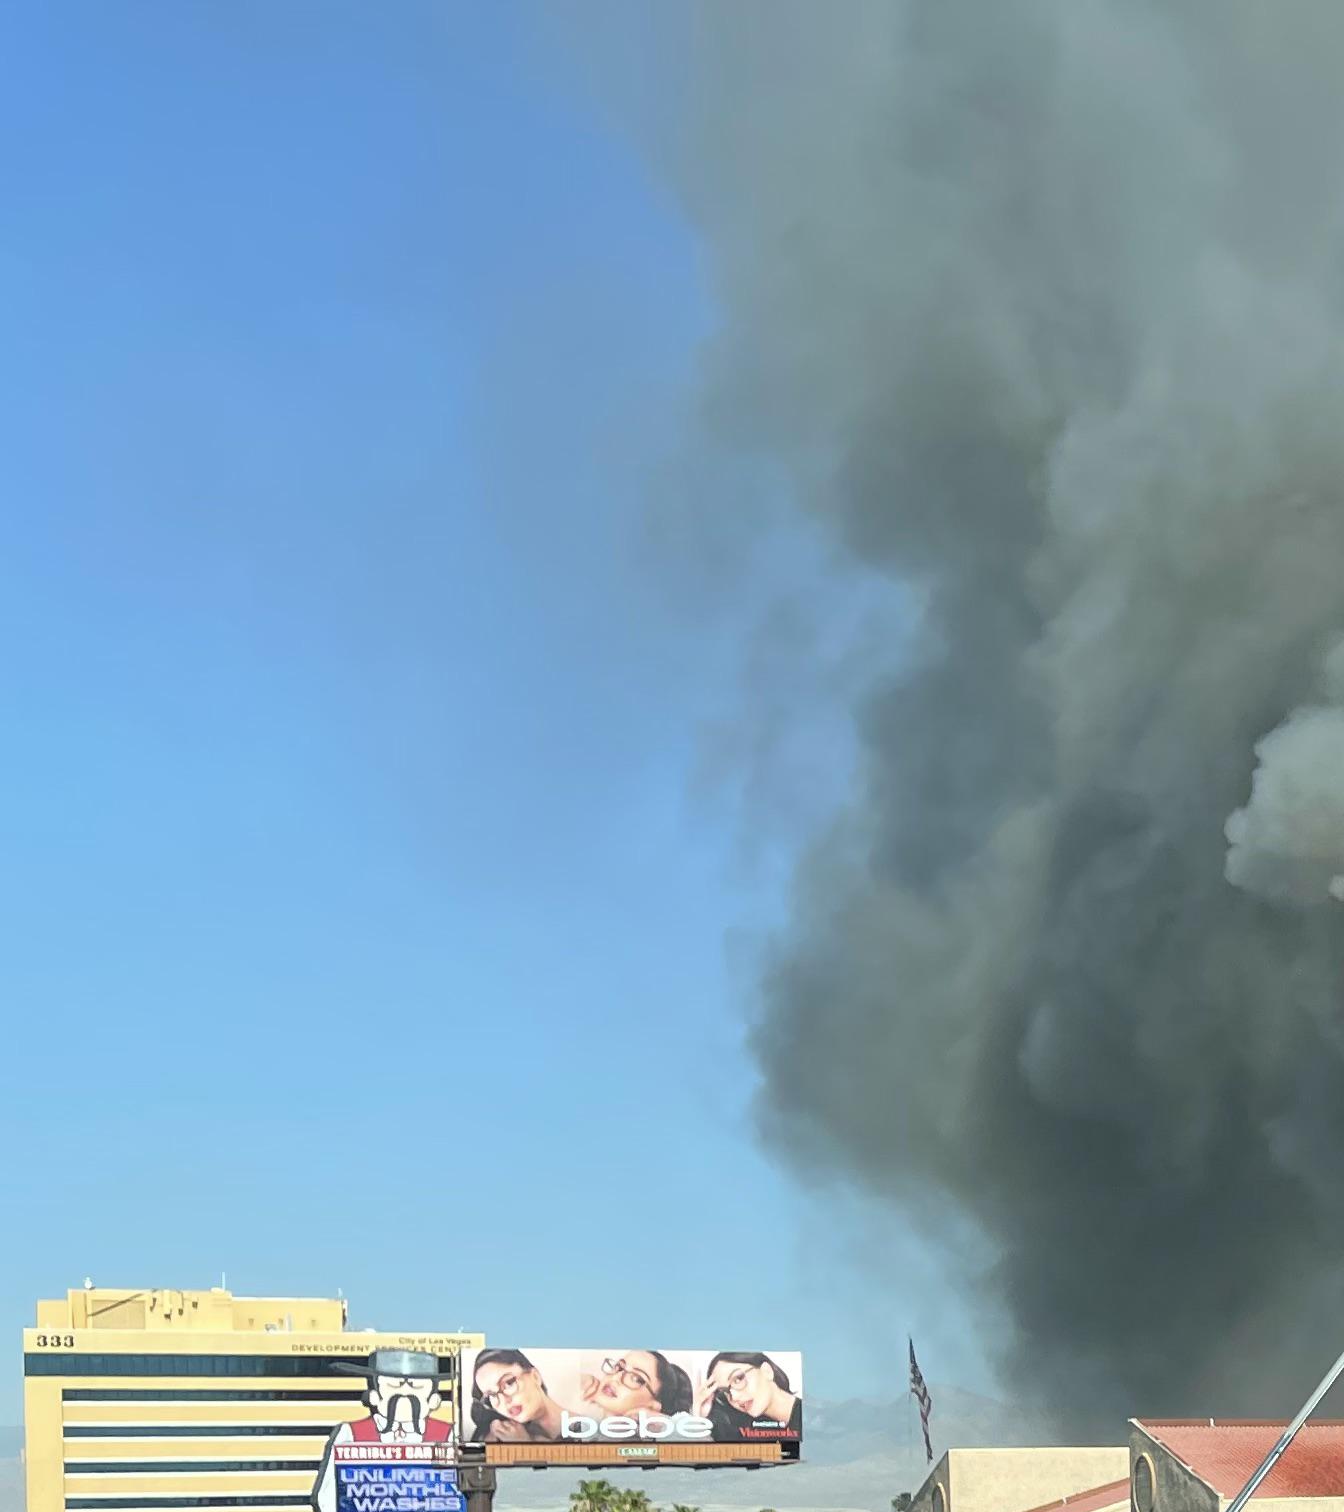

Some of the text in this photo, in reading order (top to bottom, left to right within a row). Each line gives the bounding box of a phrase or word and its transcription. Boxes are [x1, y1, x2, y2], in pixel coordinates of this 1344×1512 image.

[37, 1334, 75, 1348] 333
[291, 1344, 371, 1352] DEVELOPMENT
[399, 1337, 415, 1345] City
[561, 1410, 714, 1439] bebe
[739, 1427, 800, 1438] Visionworks
[336, 1446, 402, 1460] TERRIBLE'S
[353, 1497, 461, 1512] WASHES
